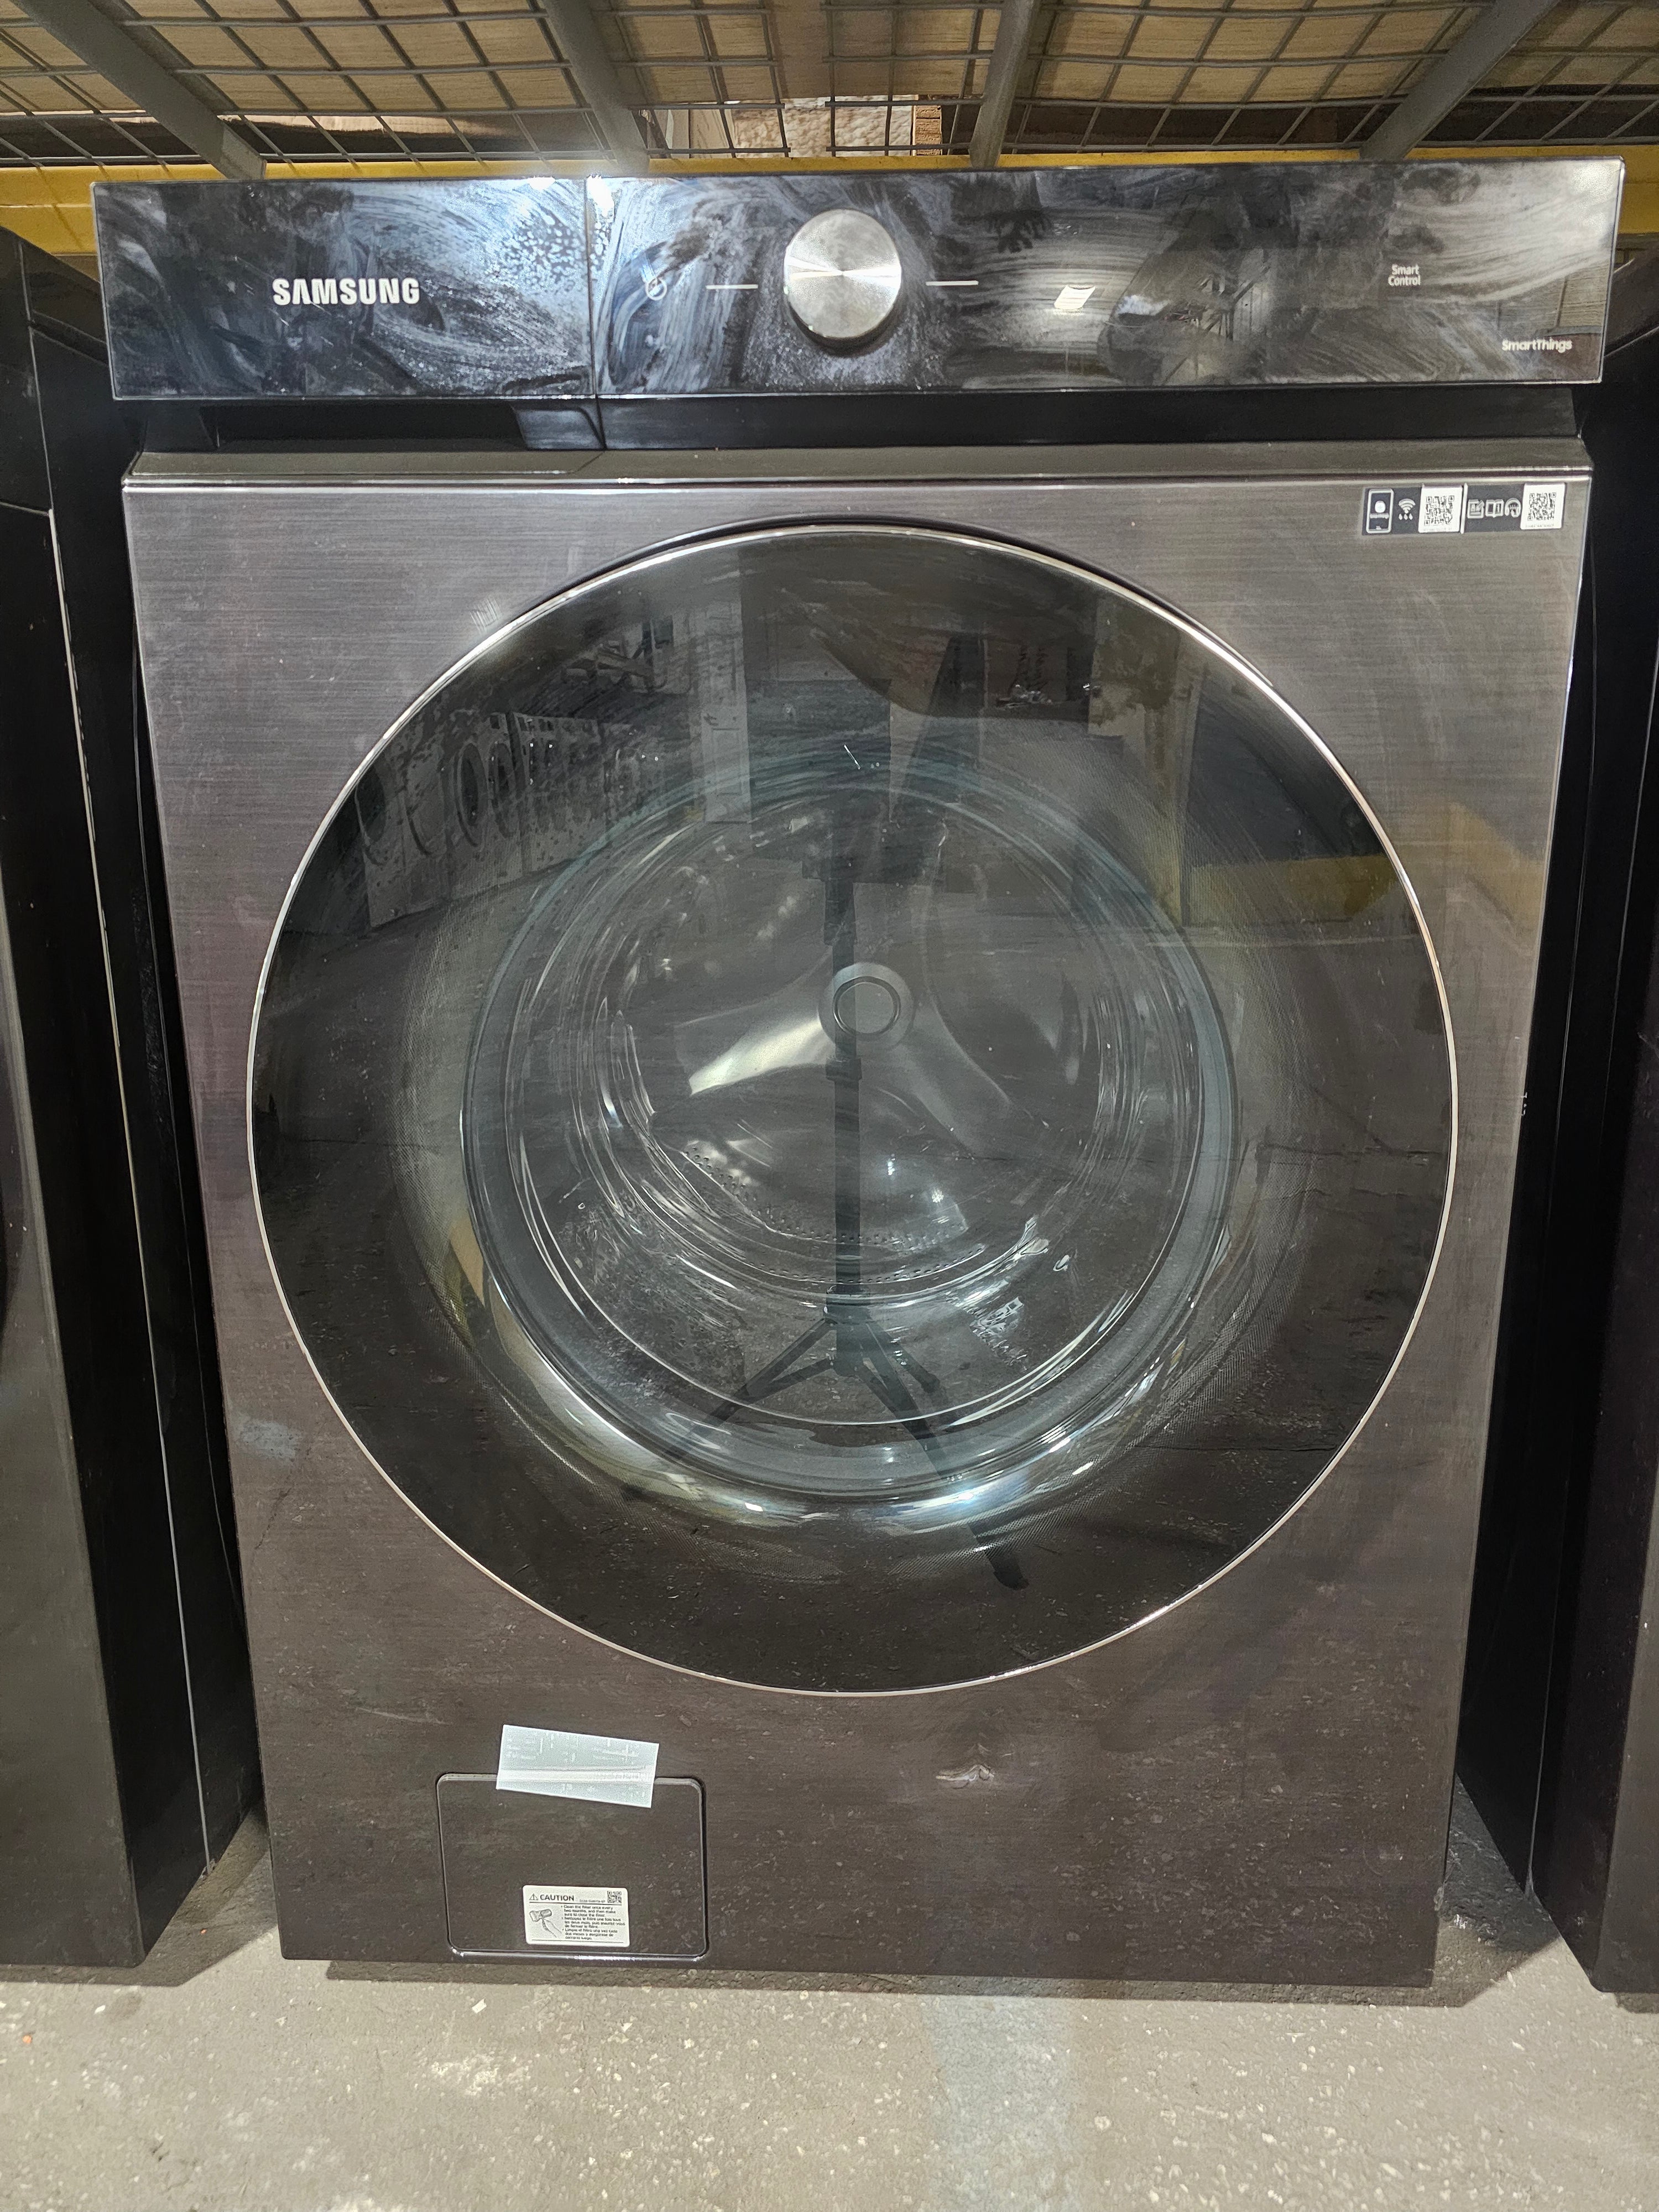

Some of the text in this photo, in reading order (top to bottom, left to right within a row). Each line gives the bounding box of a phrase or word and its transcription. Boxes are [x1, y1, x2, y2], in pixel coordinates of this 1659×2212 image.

[1391, 264, 1420, 275] Smart
[1388, 275, 1421, 286] Control
[272, 278, 420, 305] SAMSUNG
[1501, 339, 1572, 353] SmartThings
